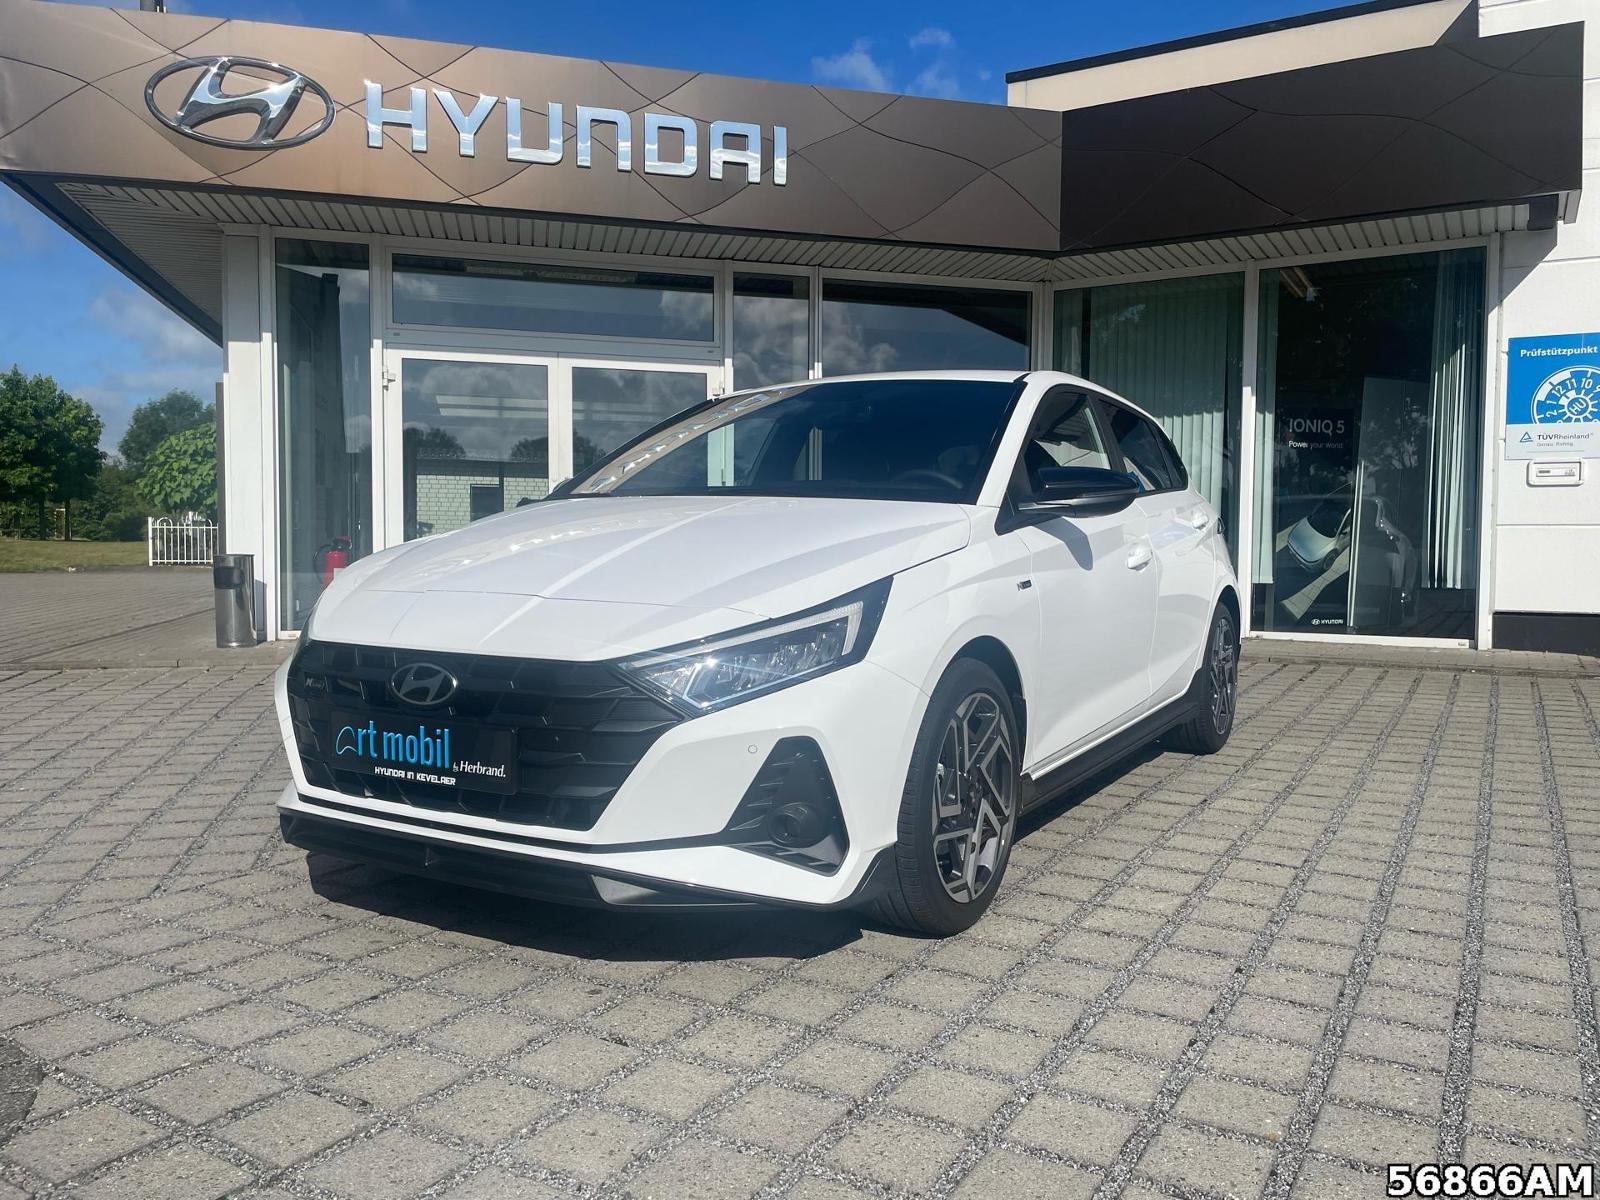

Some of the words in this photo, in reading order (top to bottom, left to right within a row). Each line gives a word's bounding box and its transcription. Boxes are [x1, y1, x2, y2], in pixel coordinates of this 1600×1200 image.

[363, 79, 788, 186] HYUNDAI
[1520, 346, 1598, 357] Prüfstützpunkt
[1566, 378, 1577, 389] 11
[1581, 378, 1593, 389] 10
[1552, 385, 1566, 397] 12
[1546, 409, 1558, 417] 2
[1569, 399, 1587, 415] HU
[1289, 418, 1333, 436] IONIQ
[1336, 420, 1345, 433] 5
[1288, 440, 1308, 448] Power
[382, 725, 450, 769] mobil
[374, 766, 406, 778] HYUNDAI
[416, 772, 456, 786] KEVELAER
[459, 760, 506, 778] Herbrand.
